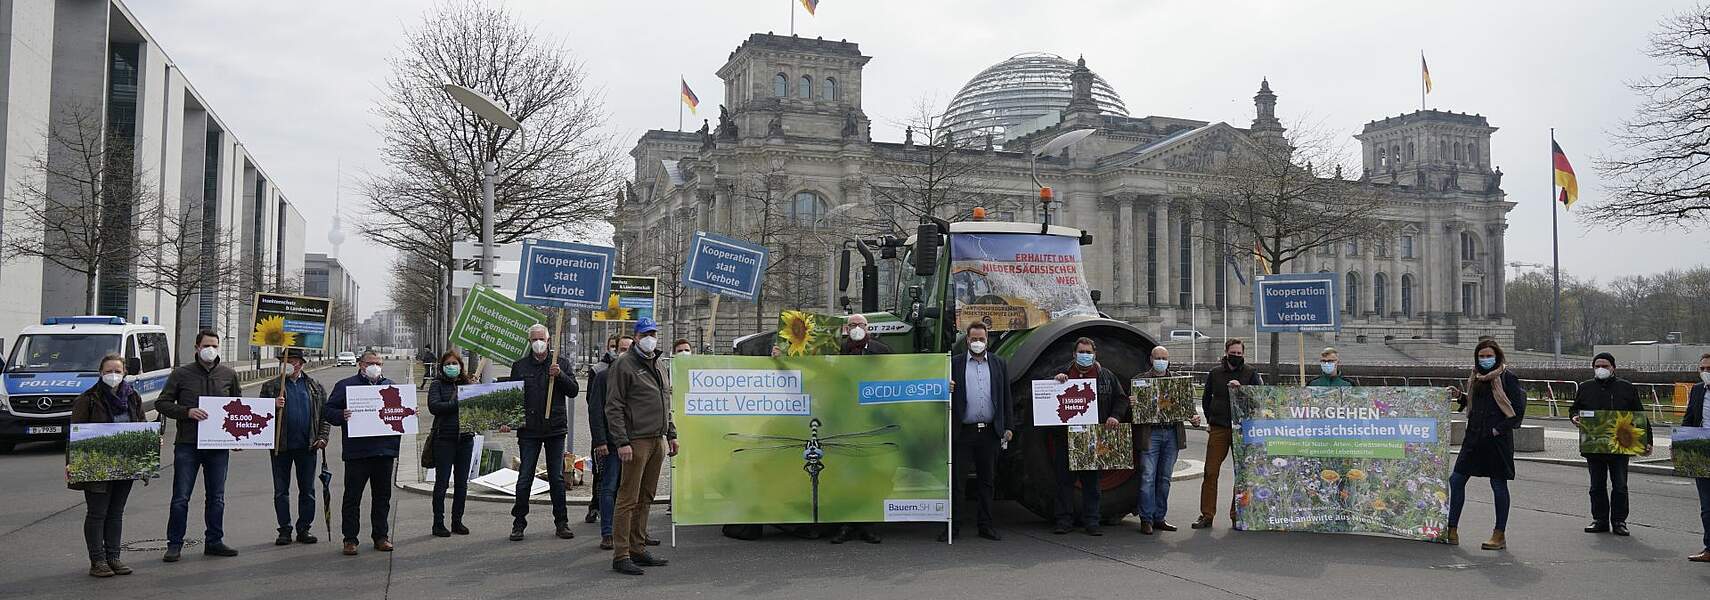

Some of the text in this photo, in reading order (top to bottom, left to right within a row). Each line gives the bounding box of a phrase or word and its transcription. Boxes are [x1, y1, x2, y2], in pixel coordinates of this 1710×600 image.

[702, 244, 756, 265] Kooperation
[1015, 253, 1075, 263] ERHALTET DEN
[535, 254, 600, 271] Kooperation
[715, 262, 736, 273] statt
[982, 263, 1077, 275] NIEDERSÄCHSISCHEN
[554, 271, 578, 282] statt
[706, 271, 740, 287] Verbote
[1056, 276, 1078, 285] WEG!
[543, 283, 585, 297] Verbote
[1266, 286, 1326, 298] Kooperation
[1285, 300, 1308, 309] statt
[476, 302, 530, 334] Insektenschutz
[1277, 312, 1317, 321] Verbote
[470, 314, 527, 345] nur gemeinsam
[465, 323, 523, 355] MIT den Bauern
[19, 379, 82, 388] POLIZEI
[691, 371, 798, 391] Kooperation
[862, 383, 942, 399] @CDU @SPD
[687, 395, 807, 412] statt Verbote!
[1289, 406, 1380, 420] WIR GEHEN
[1248, 423, 1430, 439] den Niedersächsischen Weg
[1269, 516, 1289, 525] Eure
[1290, 512, 1333, 524] Landwirte
